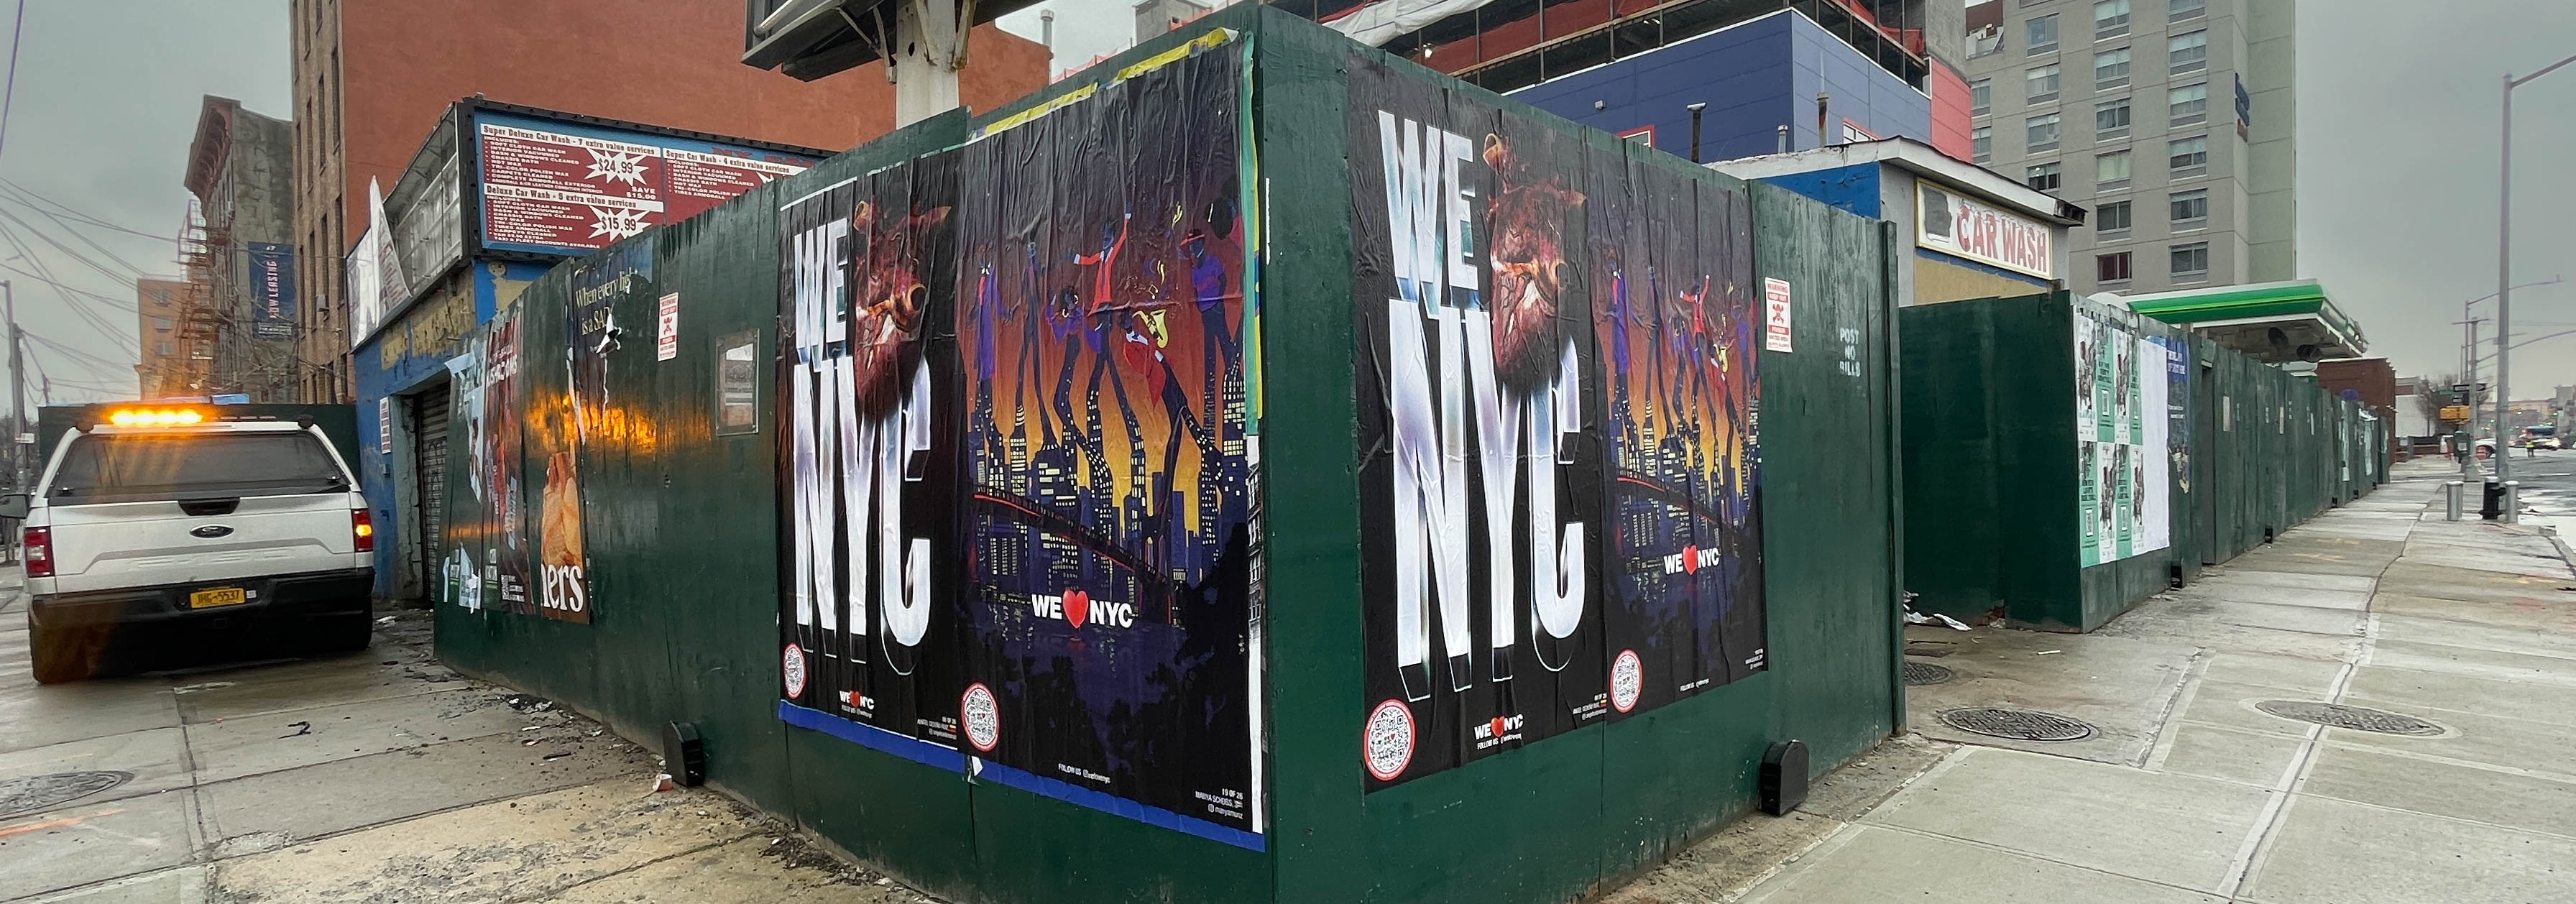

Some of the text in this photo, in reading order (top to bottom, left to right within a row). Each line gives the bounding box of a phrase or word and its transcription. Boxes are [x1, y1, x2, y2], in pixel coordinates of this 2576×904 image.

[483, 125, 505, 137] Super
[507, 128, 533, 139] Deluxe
[535, 132, 548, 141] Car
[551, 134, 571, 144] Wash
[585, 139, 603, 147] extra
[605, 141, 624, 150] value
[626, 144, 654, 154] services
[597, 157, 633, 175] $24.99
[666, 149, 684, 160] Super
[700, 154, 717, 163] Wash
[730, 158, 745, 167] extra
[765, 165, 790, 173] services
[486, 185, 512, 195] Deluxe
[515, 188, 528, 197] Car
[530, 190, 550, 199] Wash
[565, 193, 584, 202] extra
[586, 195, 605, 205] value
[607, 198, 636, 208] services
[625, 191, 656, 200] $15.00
[1378, 109, 1480, 302] WE
[601, 216, 637, 232] $15.99
[1957, 205, 2047, 273] CAR WASH
[576, 287, 597, 308] When
[598, 277, 618, 300] every
[794, 218, 848, 363] WE
[582, 318, 588, 336] is
[589, 318, 593, 333] a
[1840, 328, 1859, 344] POST
[1845, 345, 1856, 360] NO
[1839, 361, 1861, 377] BILLS
[1389, 298, 1585, 679] NYC
[794, 355, 931, 661] NYC
[1663, 548, 1719, 575] WE NYC
[1031, 594, 1133, 628] WE NYC
[840, 690, 850, 704] WE
[1474, 723, 1491, 740] WE
[1222, 788, 1243, 800] 19 OF 26
